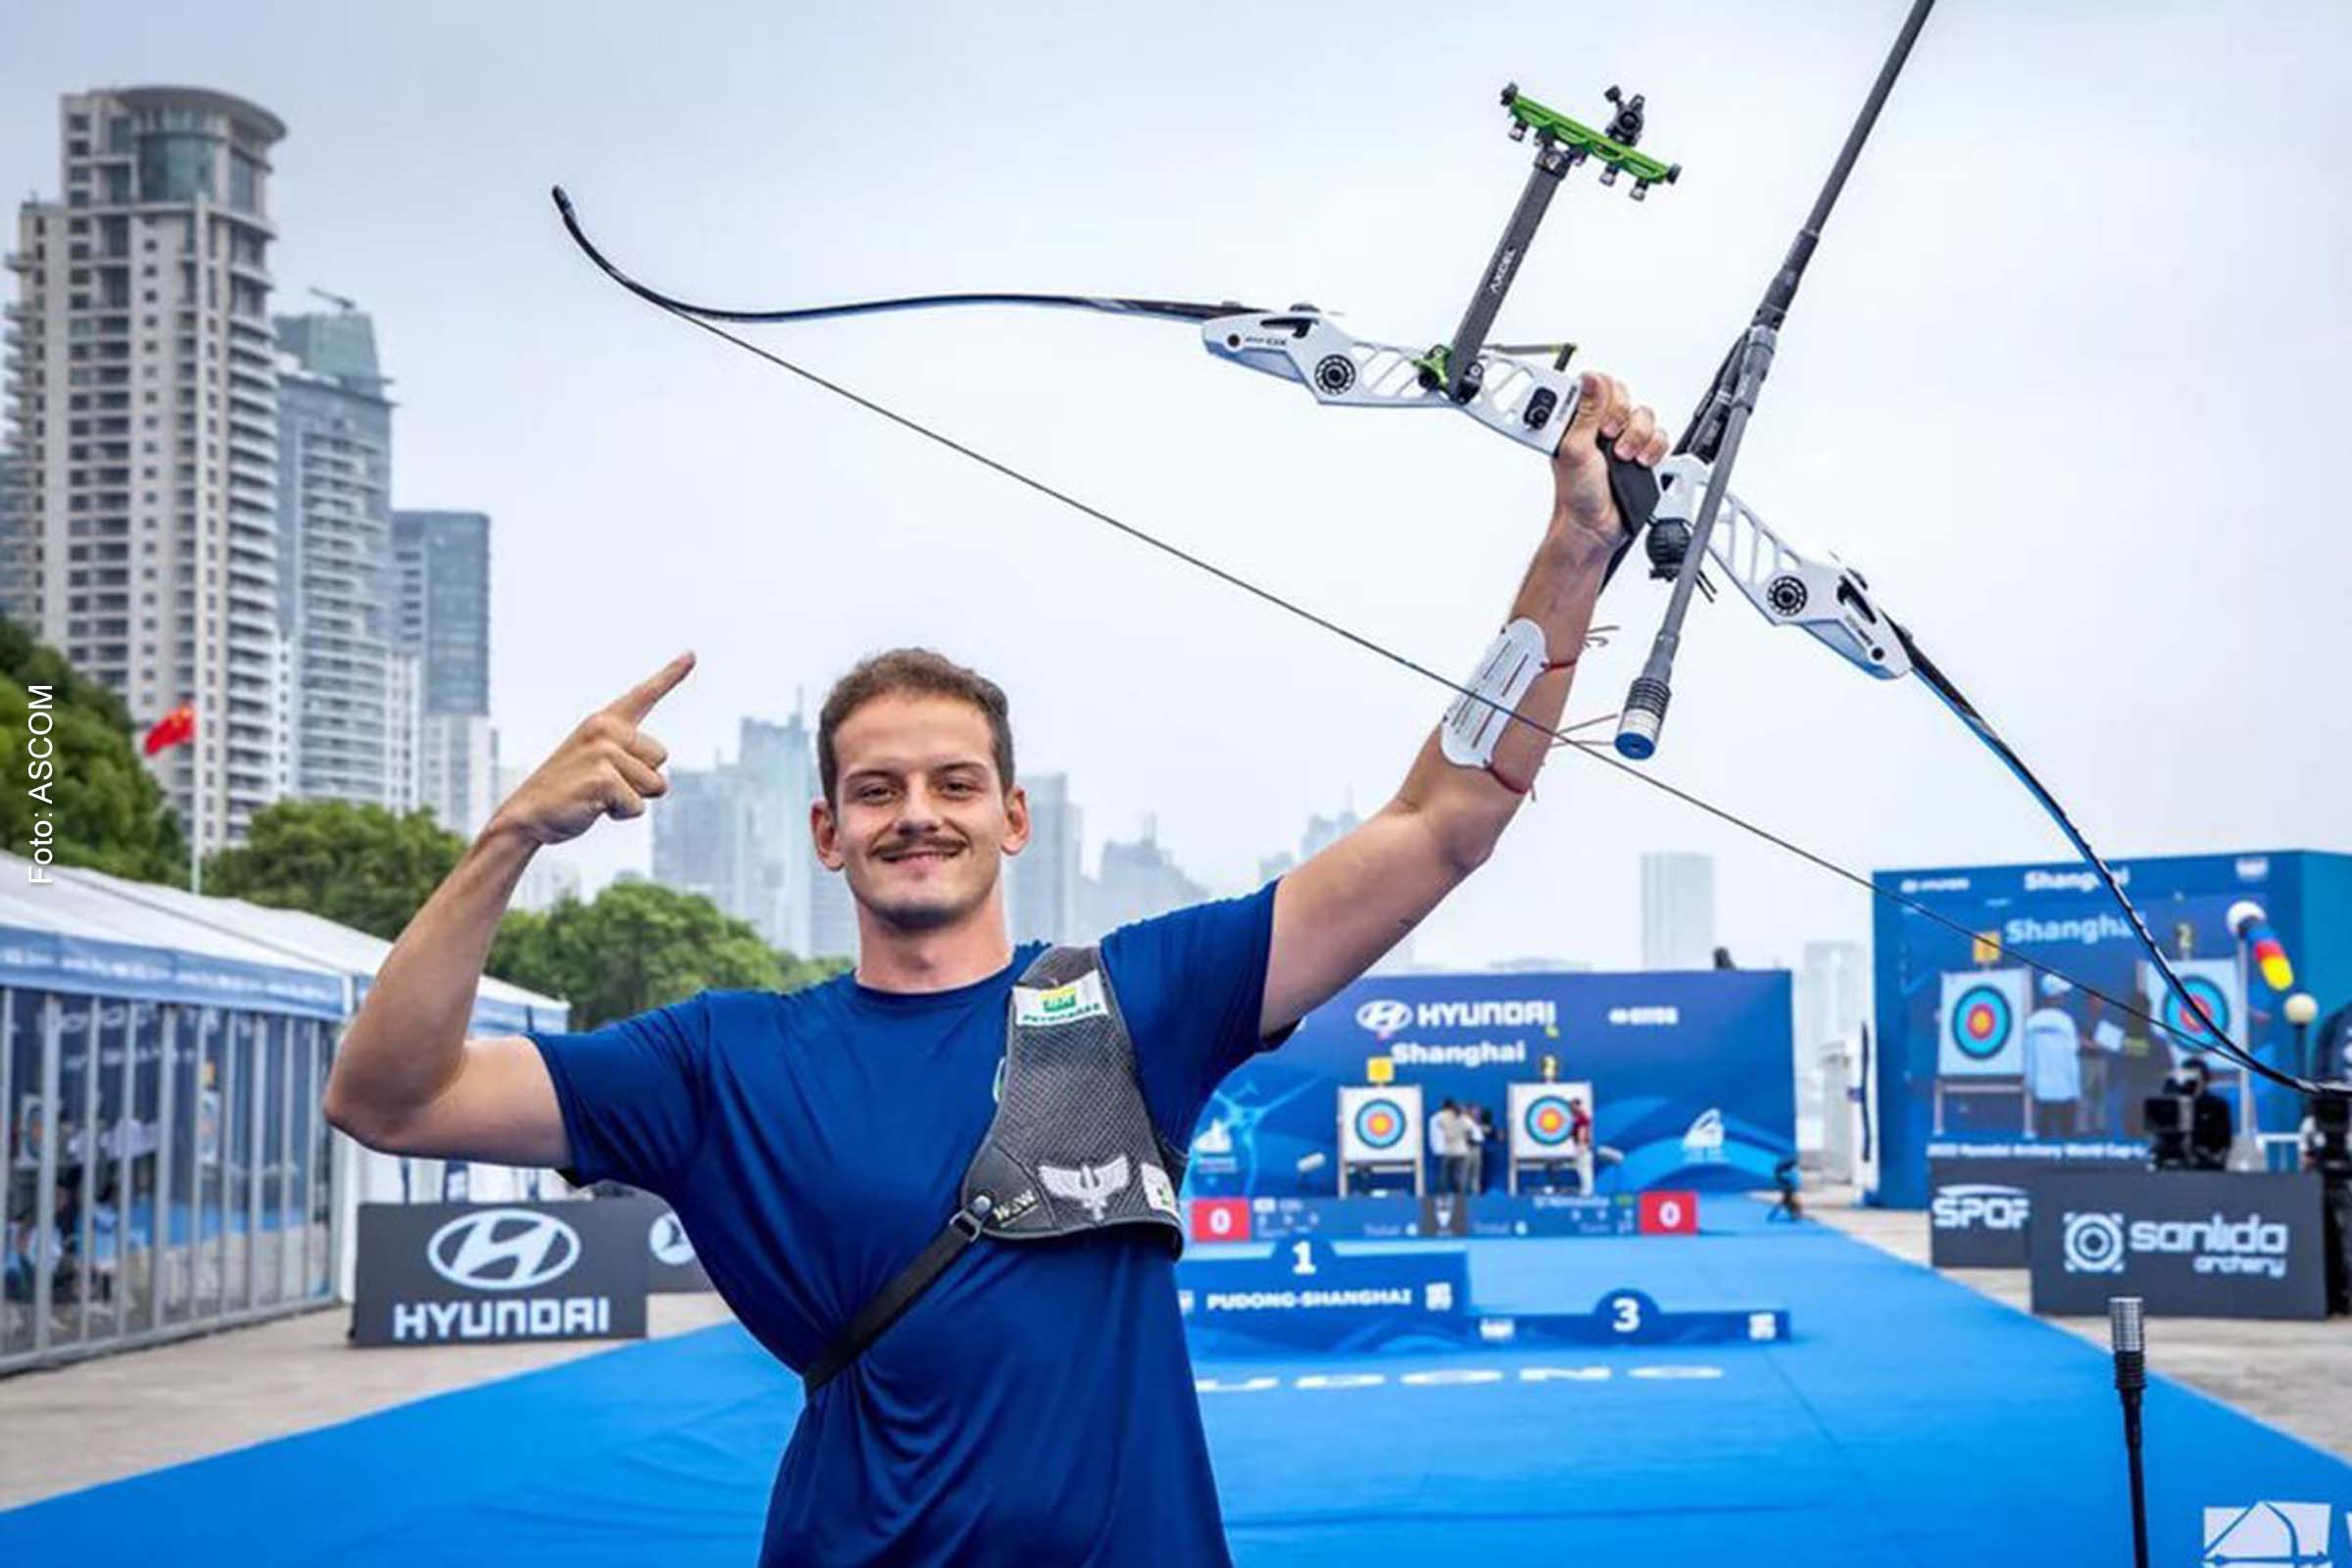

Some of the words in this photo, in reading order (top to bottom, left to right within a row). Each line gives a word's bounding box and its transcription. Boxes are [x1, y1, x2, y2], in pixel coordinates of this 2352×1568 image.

[2024, 866, 2131, 893] Shangi
[2005, 912, 2146, 946] Shangha
[1418, 1001, 1556, 1027] HYUNDAI
[1391, 1040, 1526, 1068] Shanghai
[1208, 1207, 1232, 1235] 0
[1658, 1200, 1682, 1228] 0
[2130, 1213, 2288, 1253] sanlida
[1291, 1240, 1317, 1275] 1
[2192, 1255, 2286, 1278] archery
[394, 1298, 610, 1341] HYUNDAI
[1612, 1297, 1641, 1333] 3
